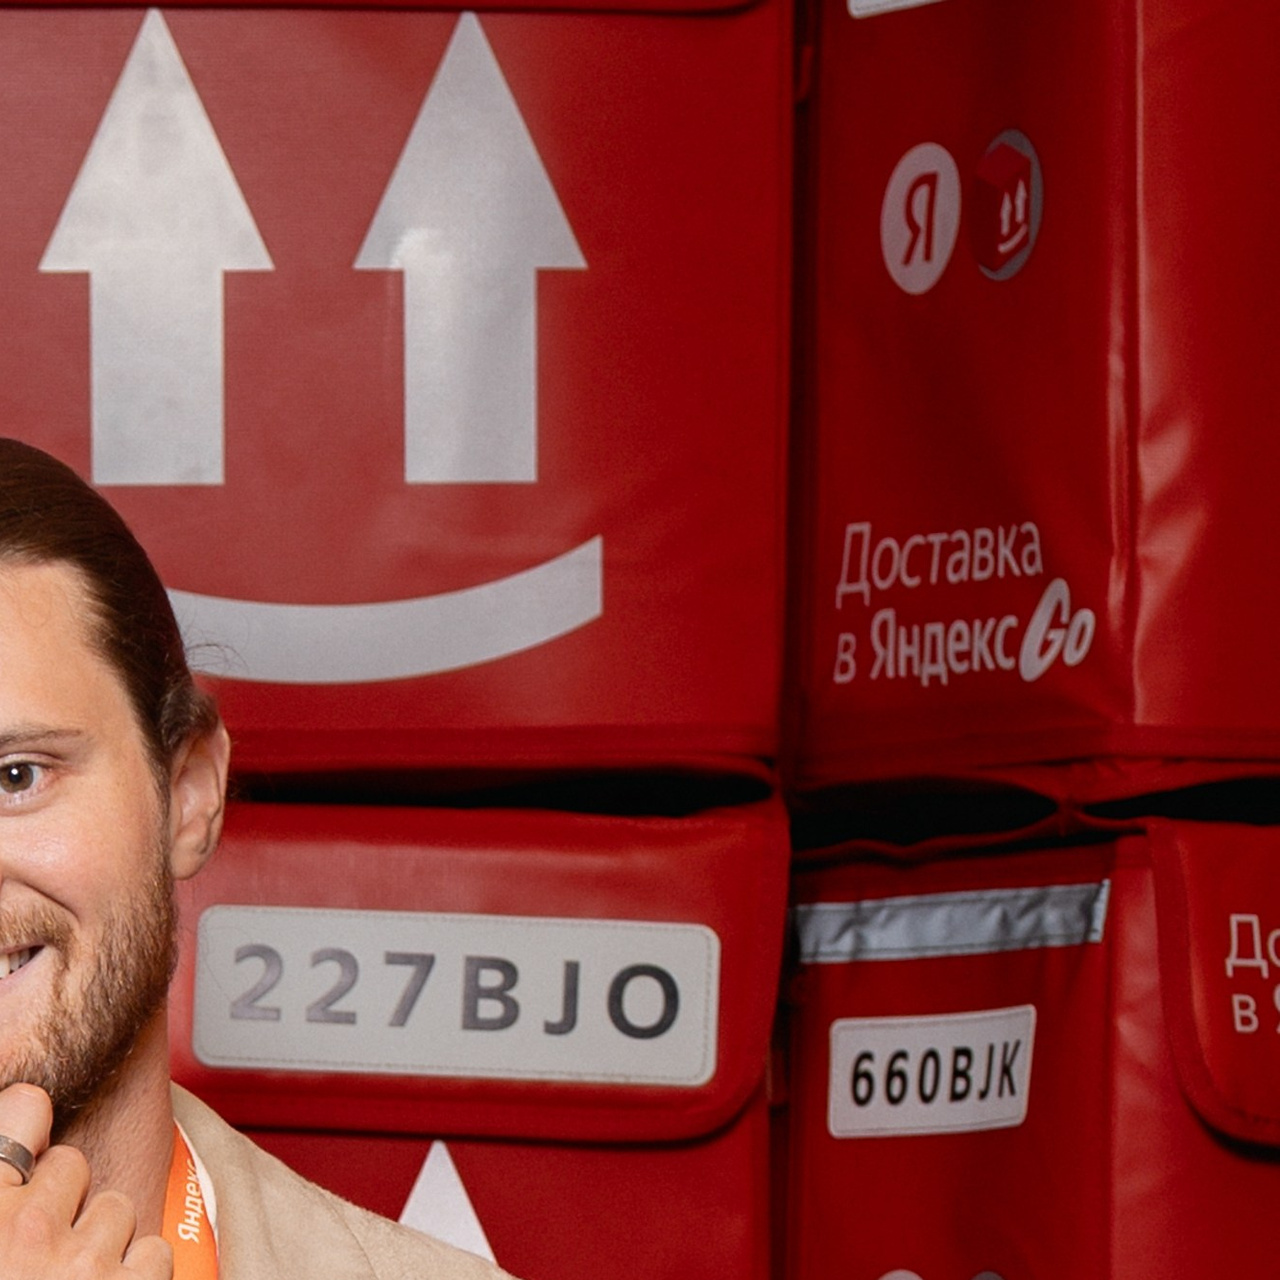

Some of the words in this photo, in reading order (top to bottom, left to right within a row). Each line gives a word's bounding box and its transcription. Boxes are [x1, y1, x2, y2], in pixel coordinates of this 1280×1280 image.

[835, 521, 1043, 609] Доставка
[832, 631, 856, 685] в
[869, 607, 1019, 688] Яндекс
[1019, 577, 1096, 682] Go
[229, 943, 681, 1040] 227BJO
[1231, 993, 1260, 1033] в
[851, 1038, 1021, 1107] 660BJK
